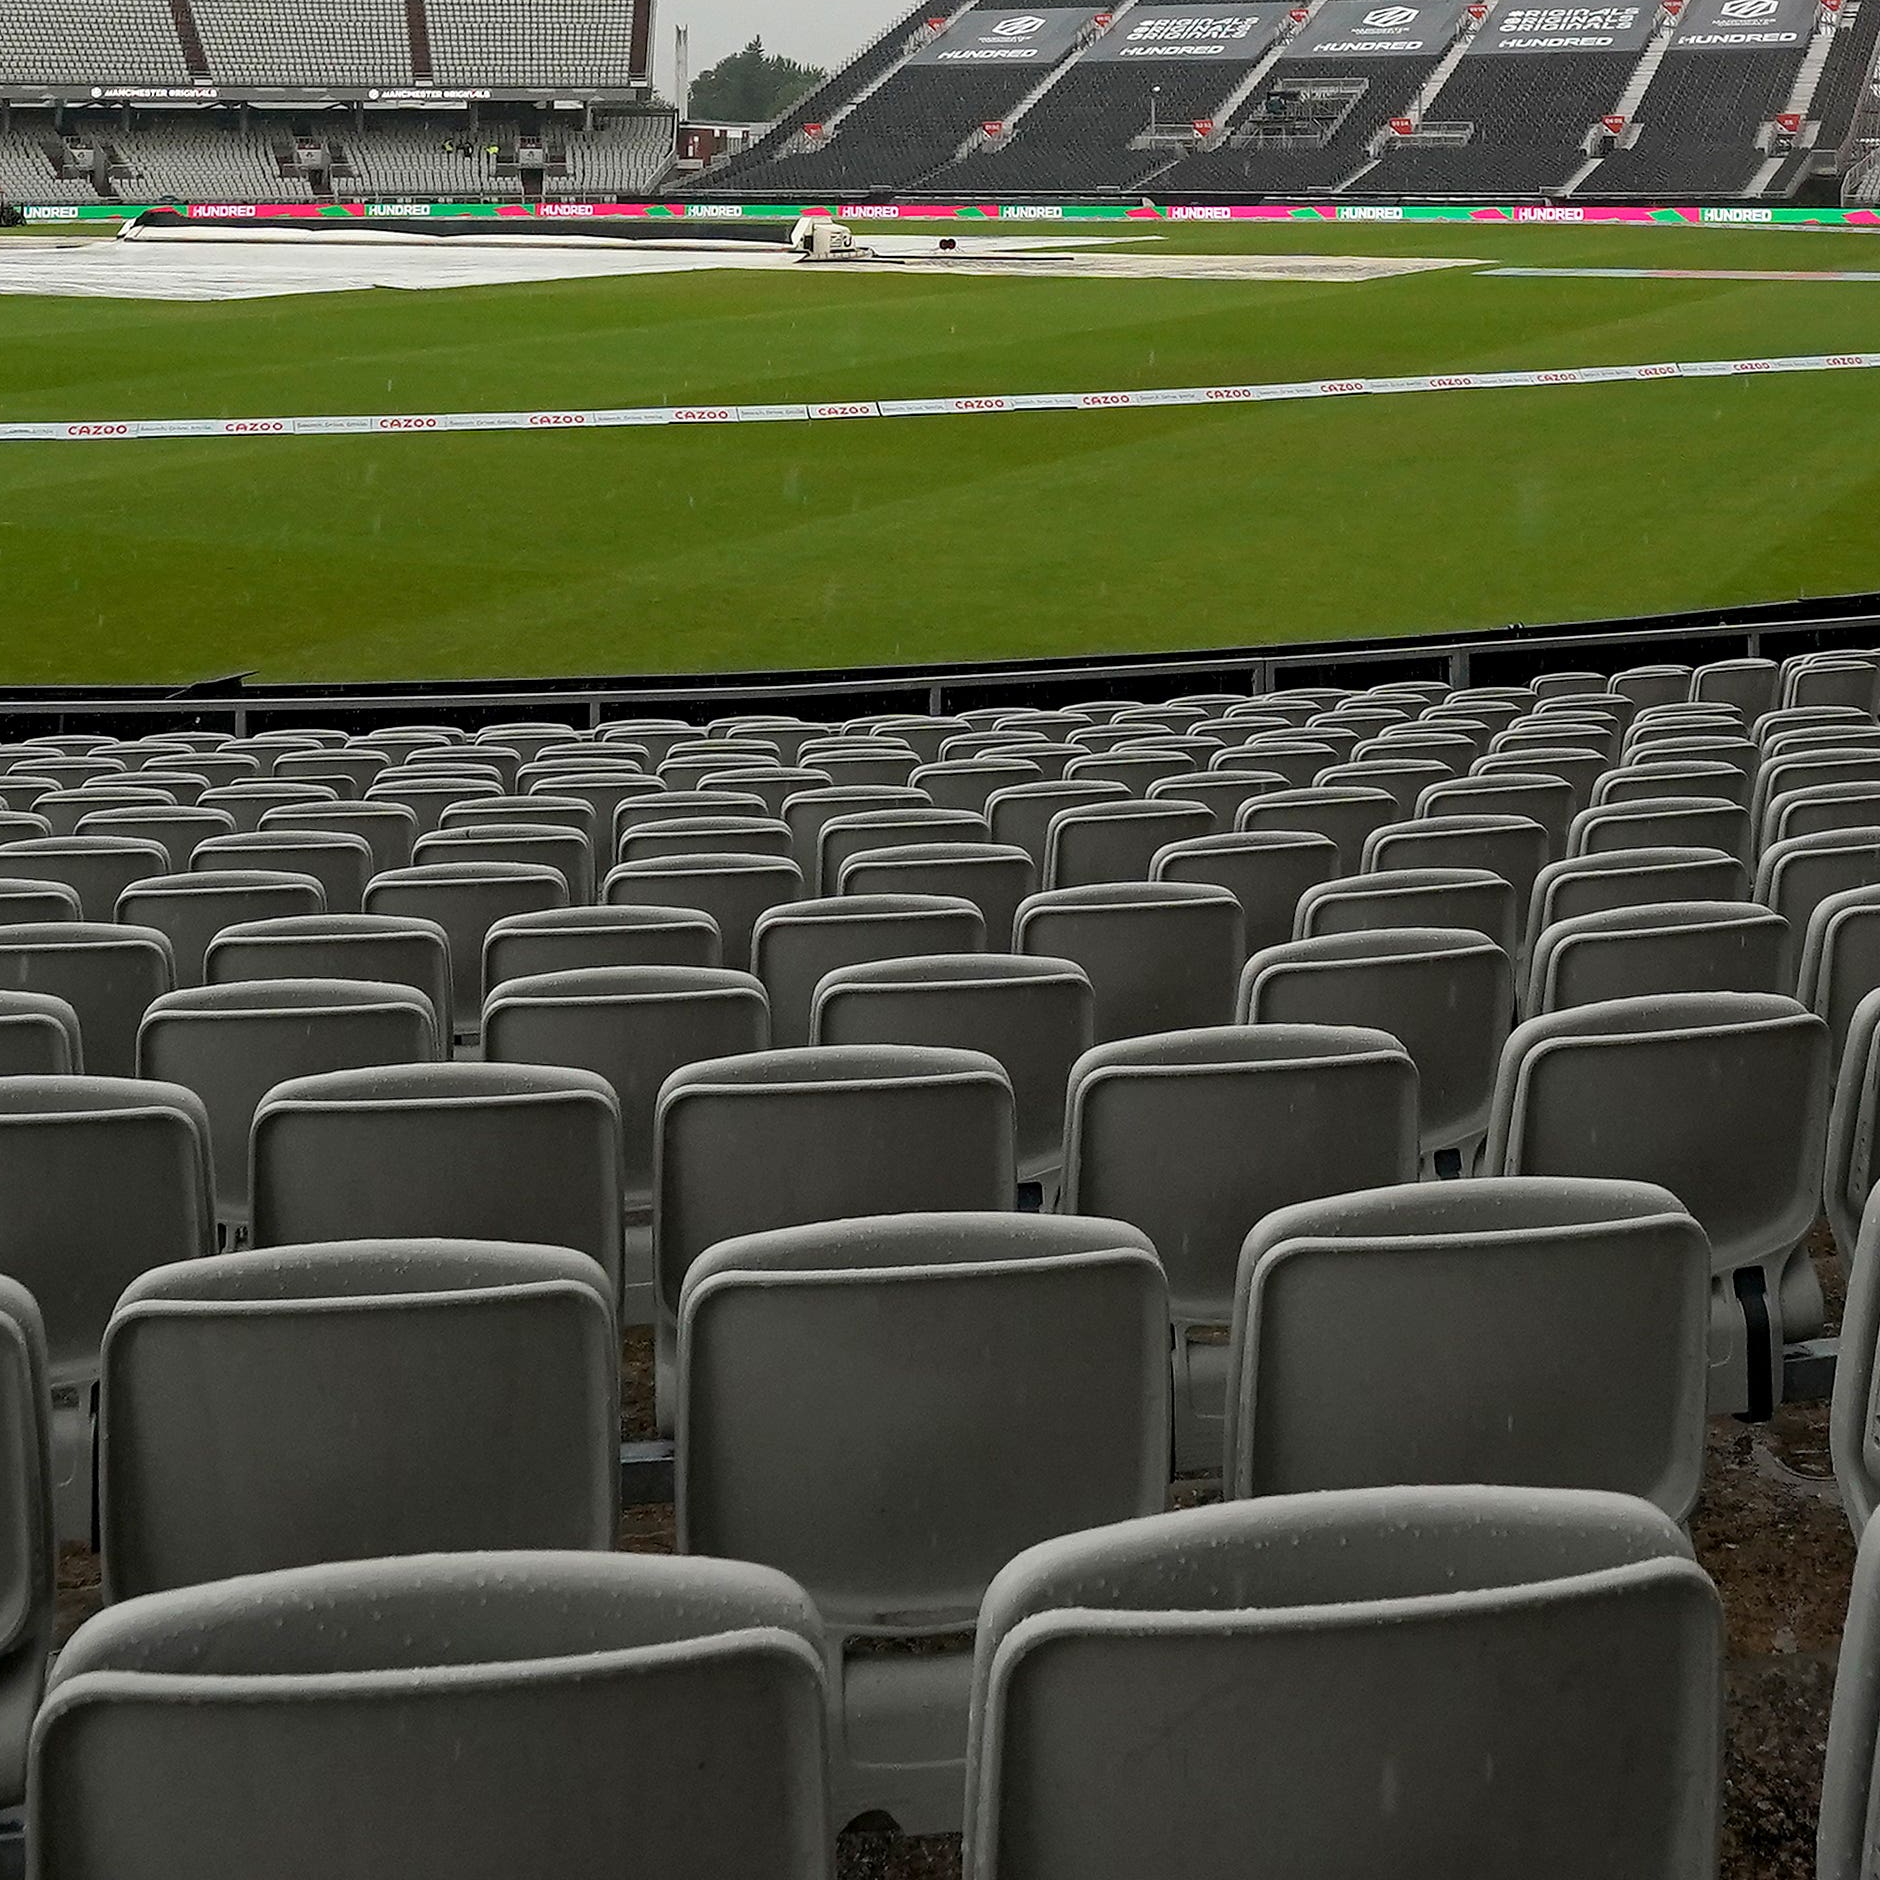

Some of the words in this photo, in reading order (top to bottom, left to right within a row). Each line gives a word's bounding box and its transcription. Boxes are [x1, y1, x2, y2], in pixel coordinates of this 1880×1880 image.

[1499, 36, 1614, 48] HUNDRED
[1678, 32, 1798, 44] HUNDRED
[1120, 45, 1225, 56] HUNDRED
[1313, 41, 1424, 52] HUNDRED
[937, 48, 1038, 60] HUNDRED
[193, 205, 255, 218] HUNDRED
[368, 204, 430, 217] HUNDRED
[540, 204, 593, 216] HUNDRED
[686, 204, 742, 218] HUNDRED
[842, 205, 899, 218] HUNDRED
[1001, 205, 1063, 220] HUNDRED
[1171, 205, 1232, 220] HUNDRED
[1341, 206, 1403, 220] HUNDRED
[1518, 207, 1584, 221] HUNDRED
[1704, 207, 1772, 223] HUNDRED
[1320, 382, 1363, 393] CAZOO
[1430, 378, 1472, 388] CAZOO
[1082, 396, 1130, 406] CAZOO
[1206, 390, 1251, 400] CAZOO
[955, 398, 1005, 409] CAZOO
[674, 410, 728, 420] CAZOO
[818, 406, 870, 417] CAZOO
[380, 417, 437, 429] CAZOO
[529, 415, 584, 425] CAZOO
[67, 425, 128, 437] CAZOO
[225, 422, 283, 432] CAZOO
